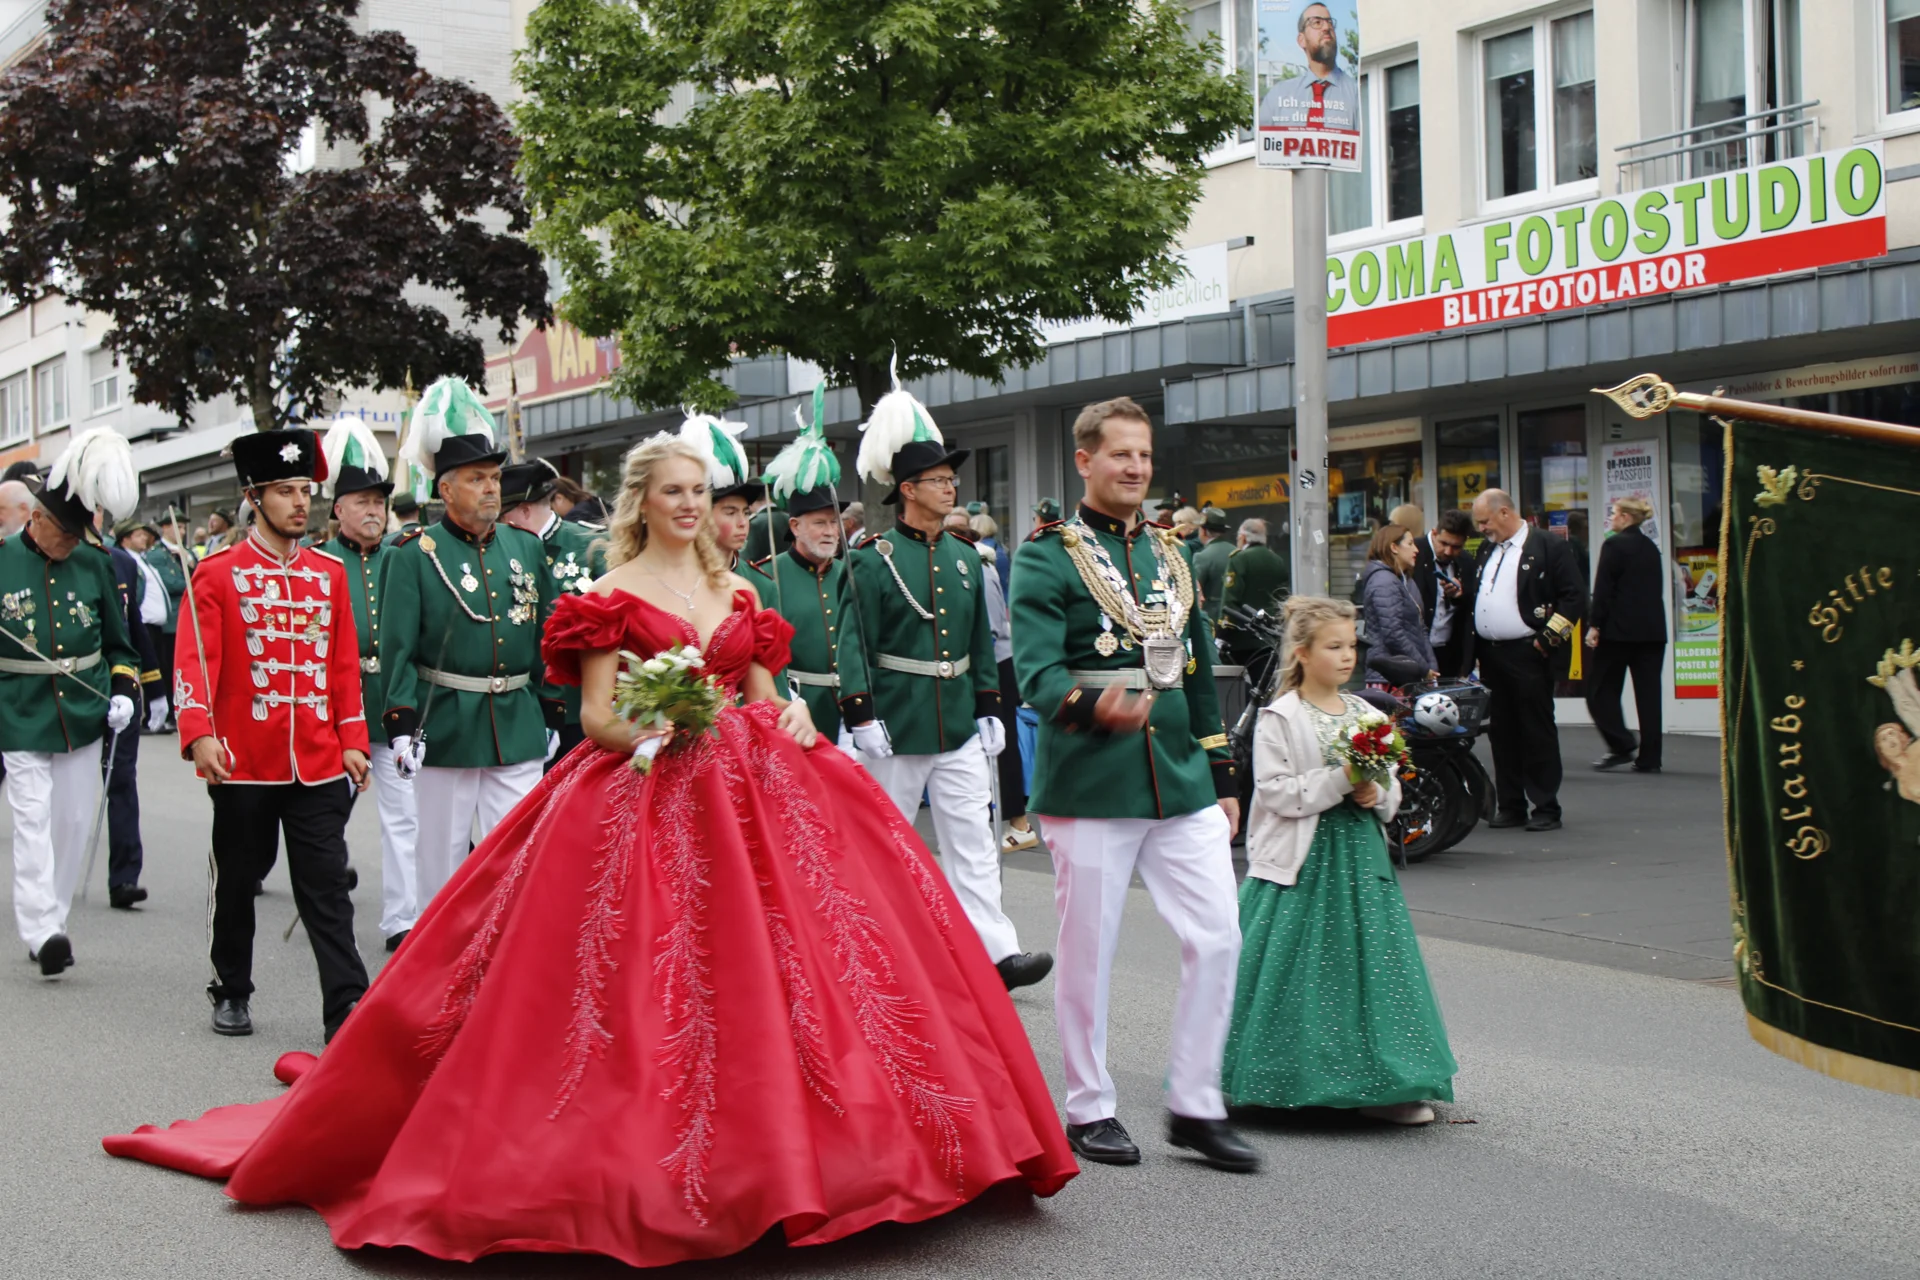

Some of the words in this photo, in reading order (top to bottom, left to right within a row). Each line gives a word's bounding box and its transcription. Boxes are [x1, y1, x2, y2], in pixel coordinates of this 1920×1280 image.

[1278, 96, 1298, 108] Ich
[1301, 99, 1322, 109] sehe
[1292, 111, 1308, 122] du
[1263, 137, 1283, 152] Die
[1283, 137, 1357, 161] PARTEI
[1327, 234, 1464, 313] COMA
[1483, 148, 1882, 284] FOTOSTUDIO
[1443, 253, 1707, 328] BLITZFOTOLABOR
[1728, 380, 1772, 396] Passbilder
[1774, 379, 1783, 390] &
[1786, 369, 1867, 389] Bewerbungsbilder
[1869, 366, 1897, 378] sofort
[1899, 362, 1919, 374] zum
[1606, 455, 1652, 470] QR-PASSBILD
[1606, 467, 1652, 484] E-PASSFOTO
[1676, 660, 1707, 669] POSTER
